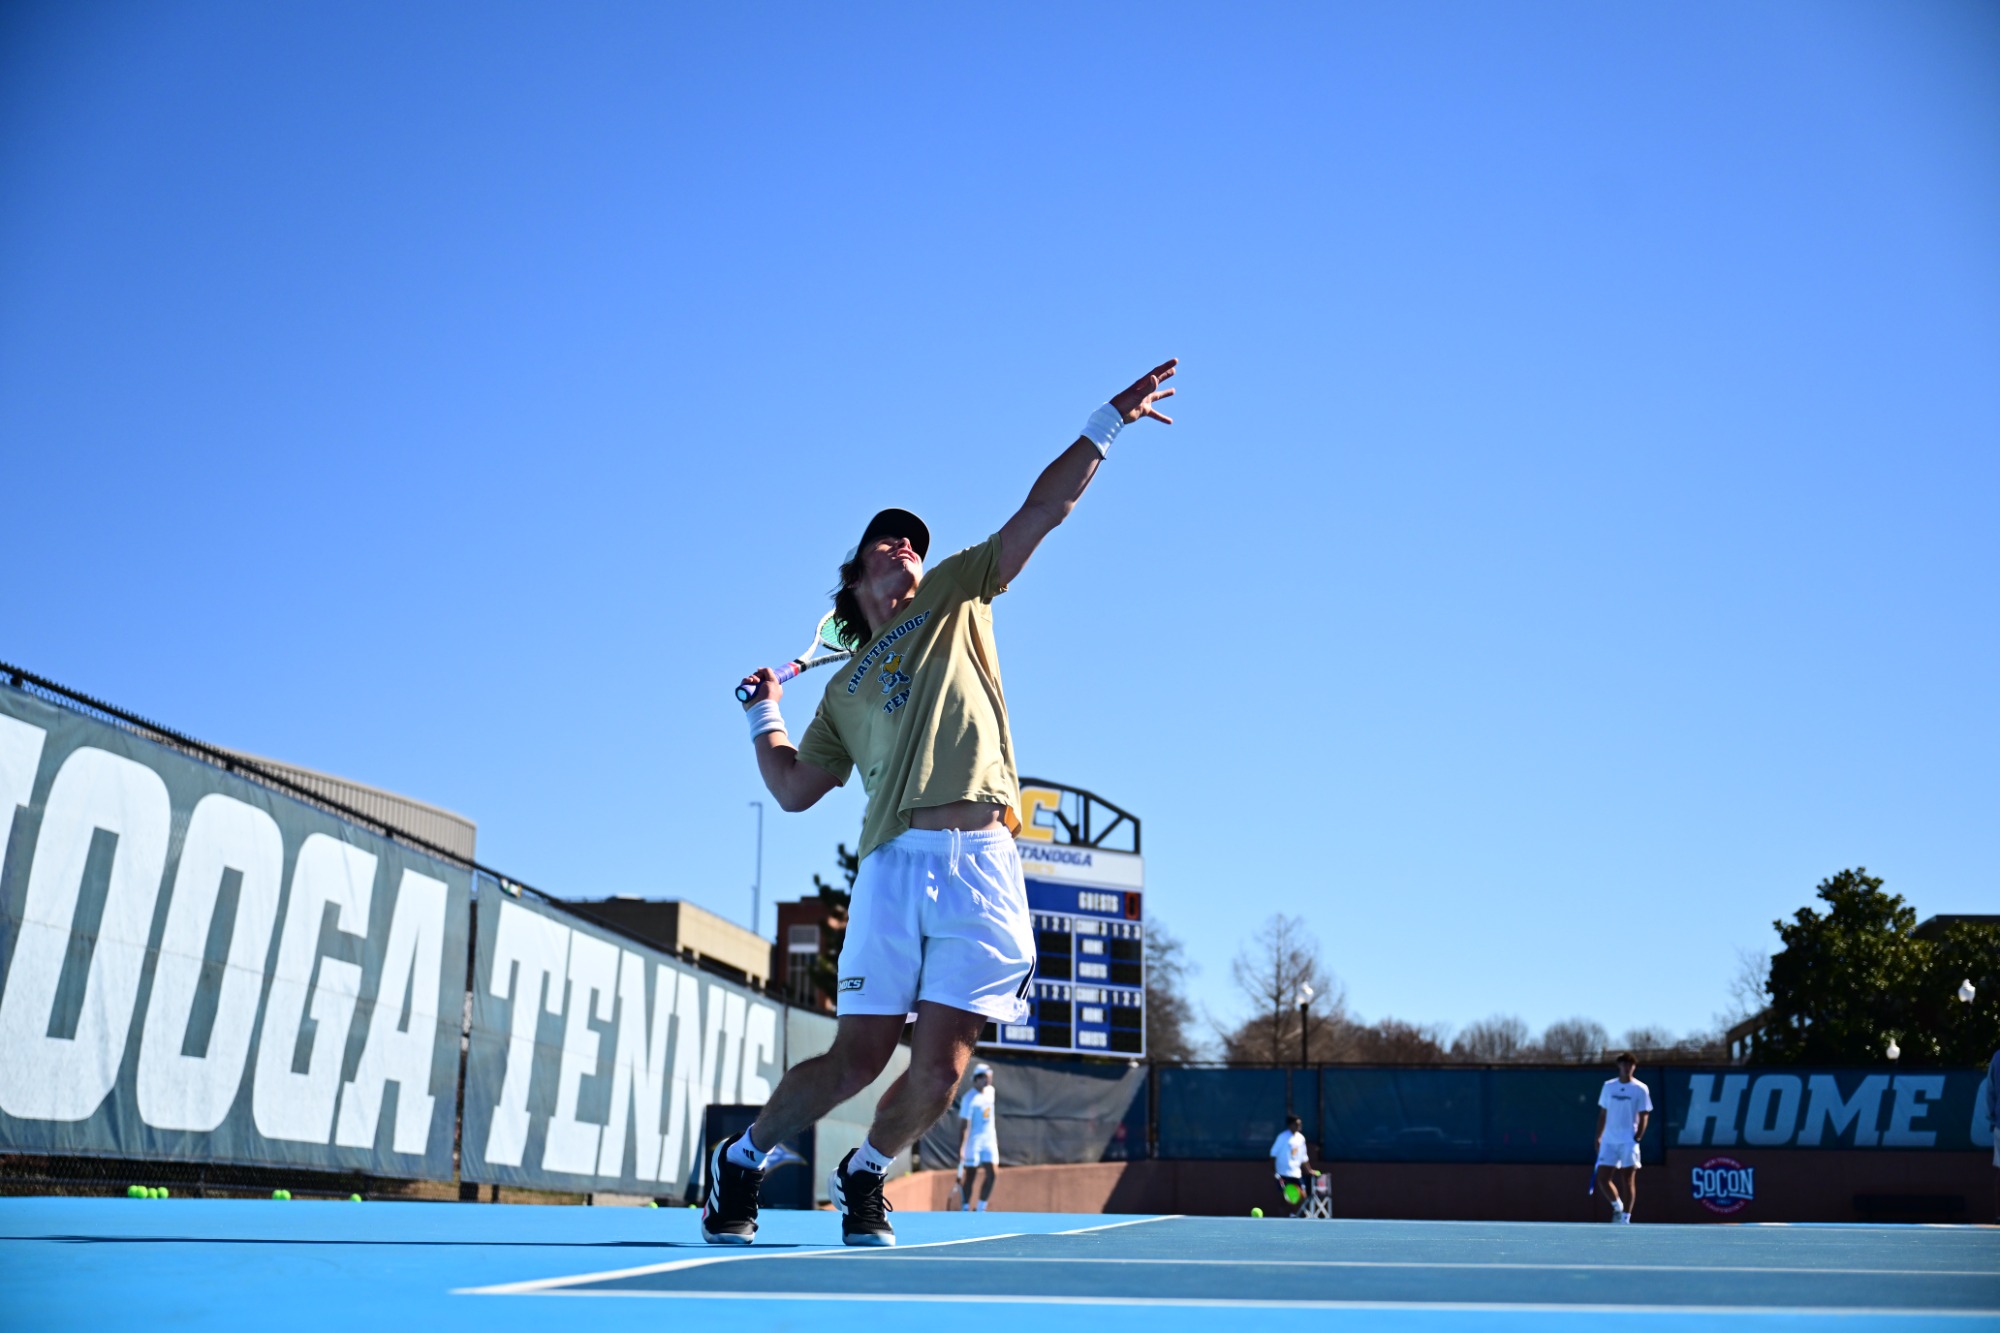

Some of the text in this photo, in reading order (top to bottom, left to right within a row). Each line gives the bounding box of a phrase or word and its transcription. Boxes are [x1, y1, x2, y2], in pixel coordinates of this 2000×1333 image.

[1020, 785, 1061, 843] C
[484, 899, 777, 1184] TENNIS
[1678, 1073, 1947, 1147] HOME
